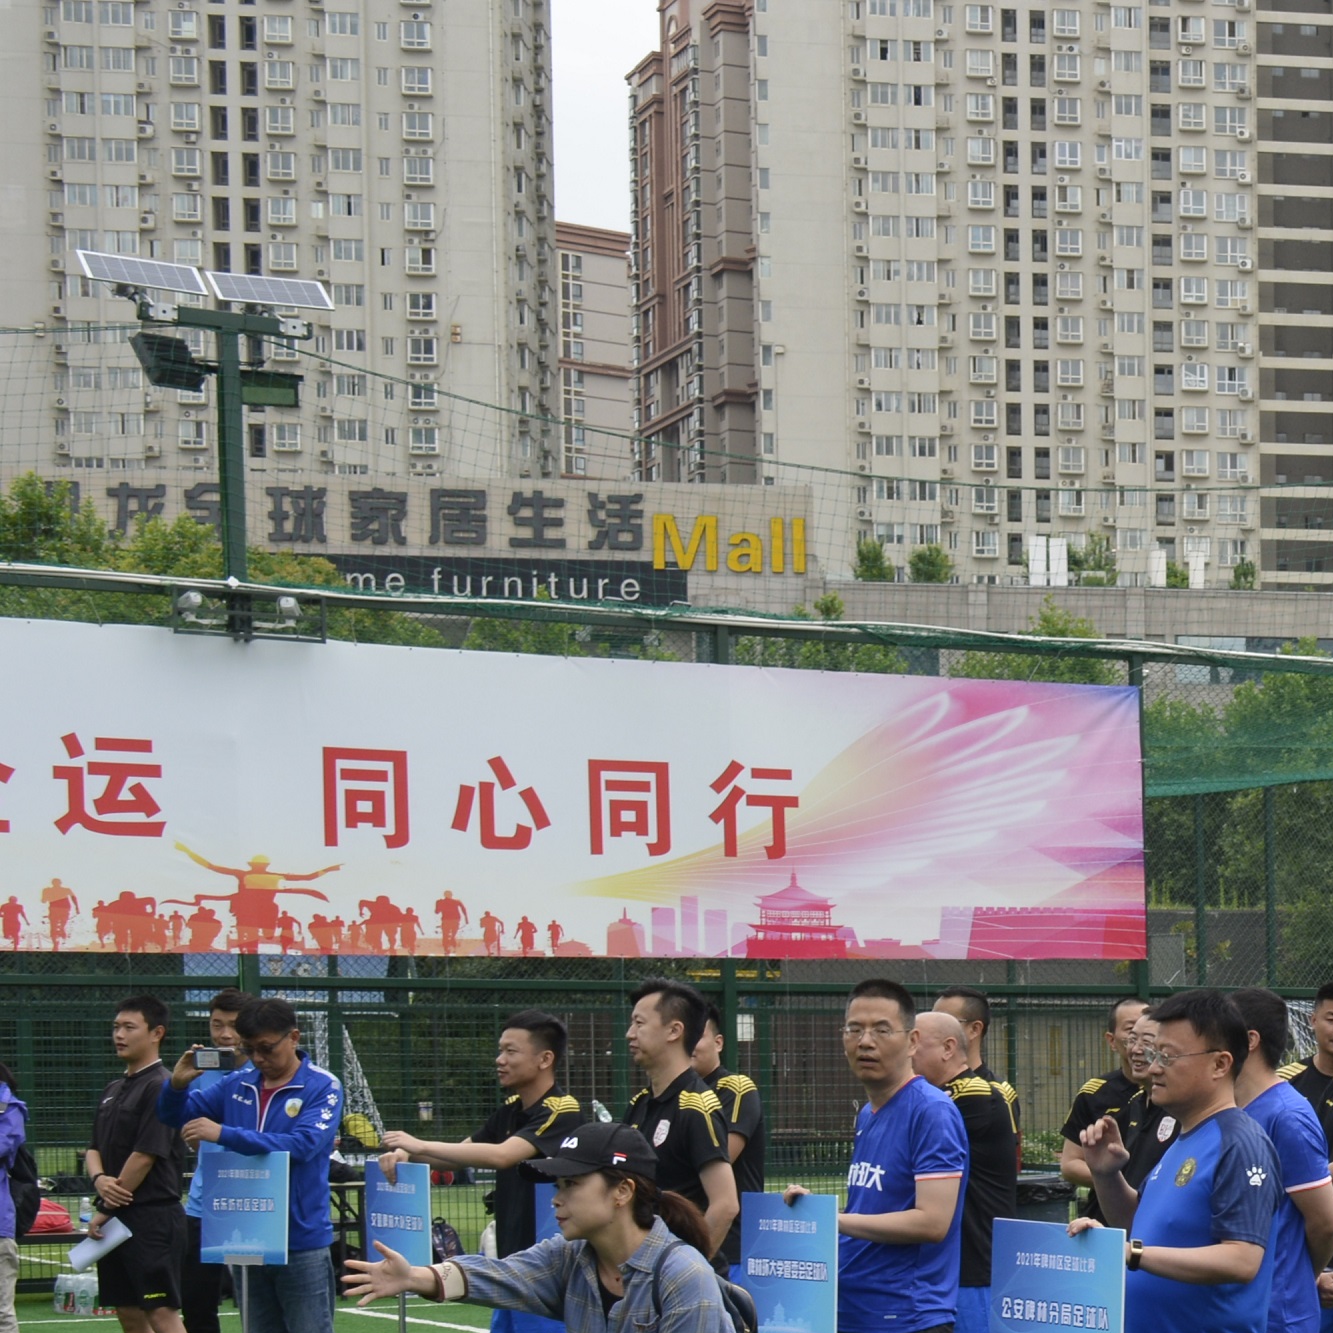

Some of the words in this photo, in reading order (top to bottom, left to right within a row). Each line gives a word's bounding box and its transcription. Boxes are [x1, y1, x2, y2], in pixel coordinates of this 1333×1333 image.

[652, 513, 806, 573] Mall
[430, 565, 642, 602] furniture
[0, 732, 166, 837] 运
[323, 745, 800, 861] 同心同行
[1015, 1251, 1097, 1274] 2021年碑林区足球比赛
[1001, 1296, 1110, 1331] 公安碑林分局足球队
